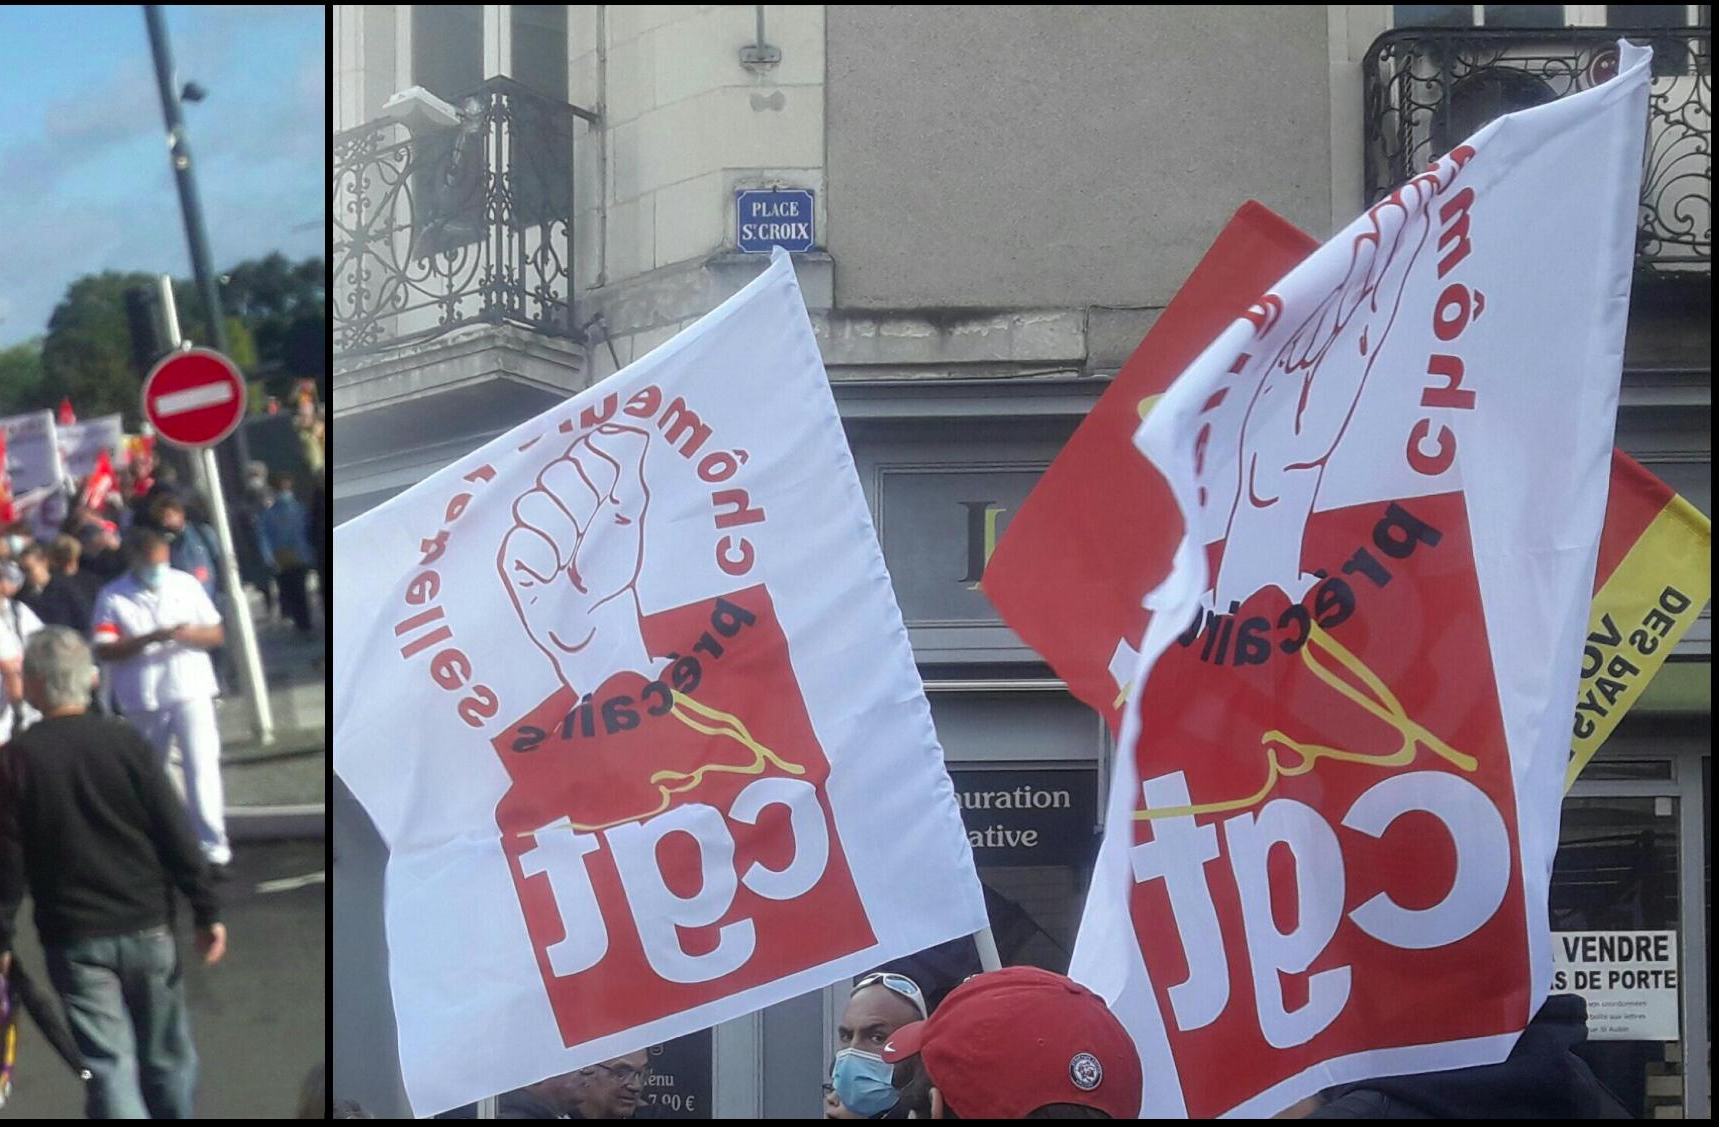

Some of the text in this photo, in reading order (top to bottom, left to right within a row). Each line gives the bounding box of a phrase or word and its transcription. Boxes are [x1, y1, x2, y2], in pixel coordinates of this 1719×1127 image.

[752, 202, 799, 217] PLACE
[758, 222, 809, 240] CROIX
[968, 824, 1039, 848] ative
[1562, 935, 1670, 962] VENDRE
[1550, 969, 1677, 991] S DE PORTE
[643, 1068, 675, 1087] énu
[685, 1095, 695, 1112] €
